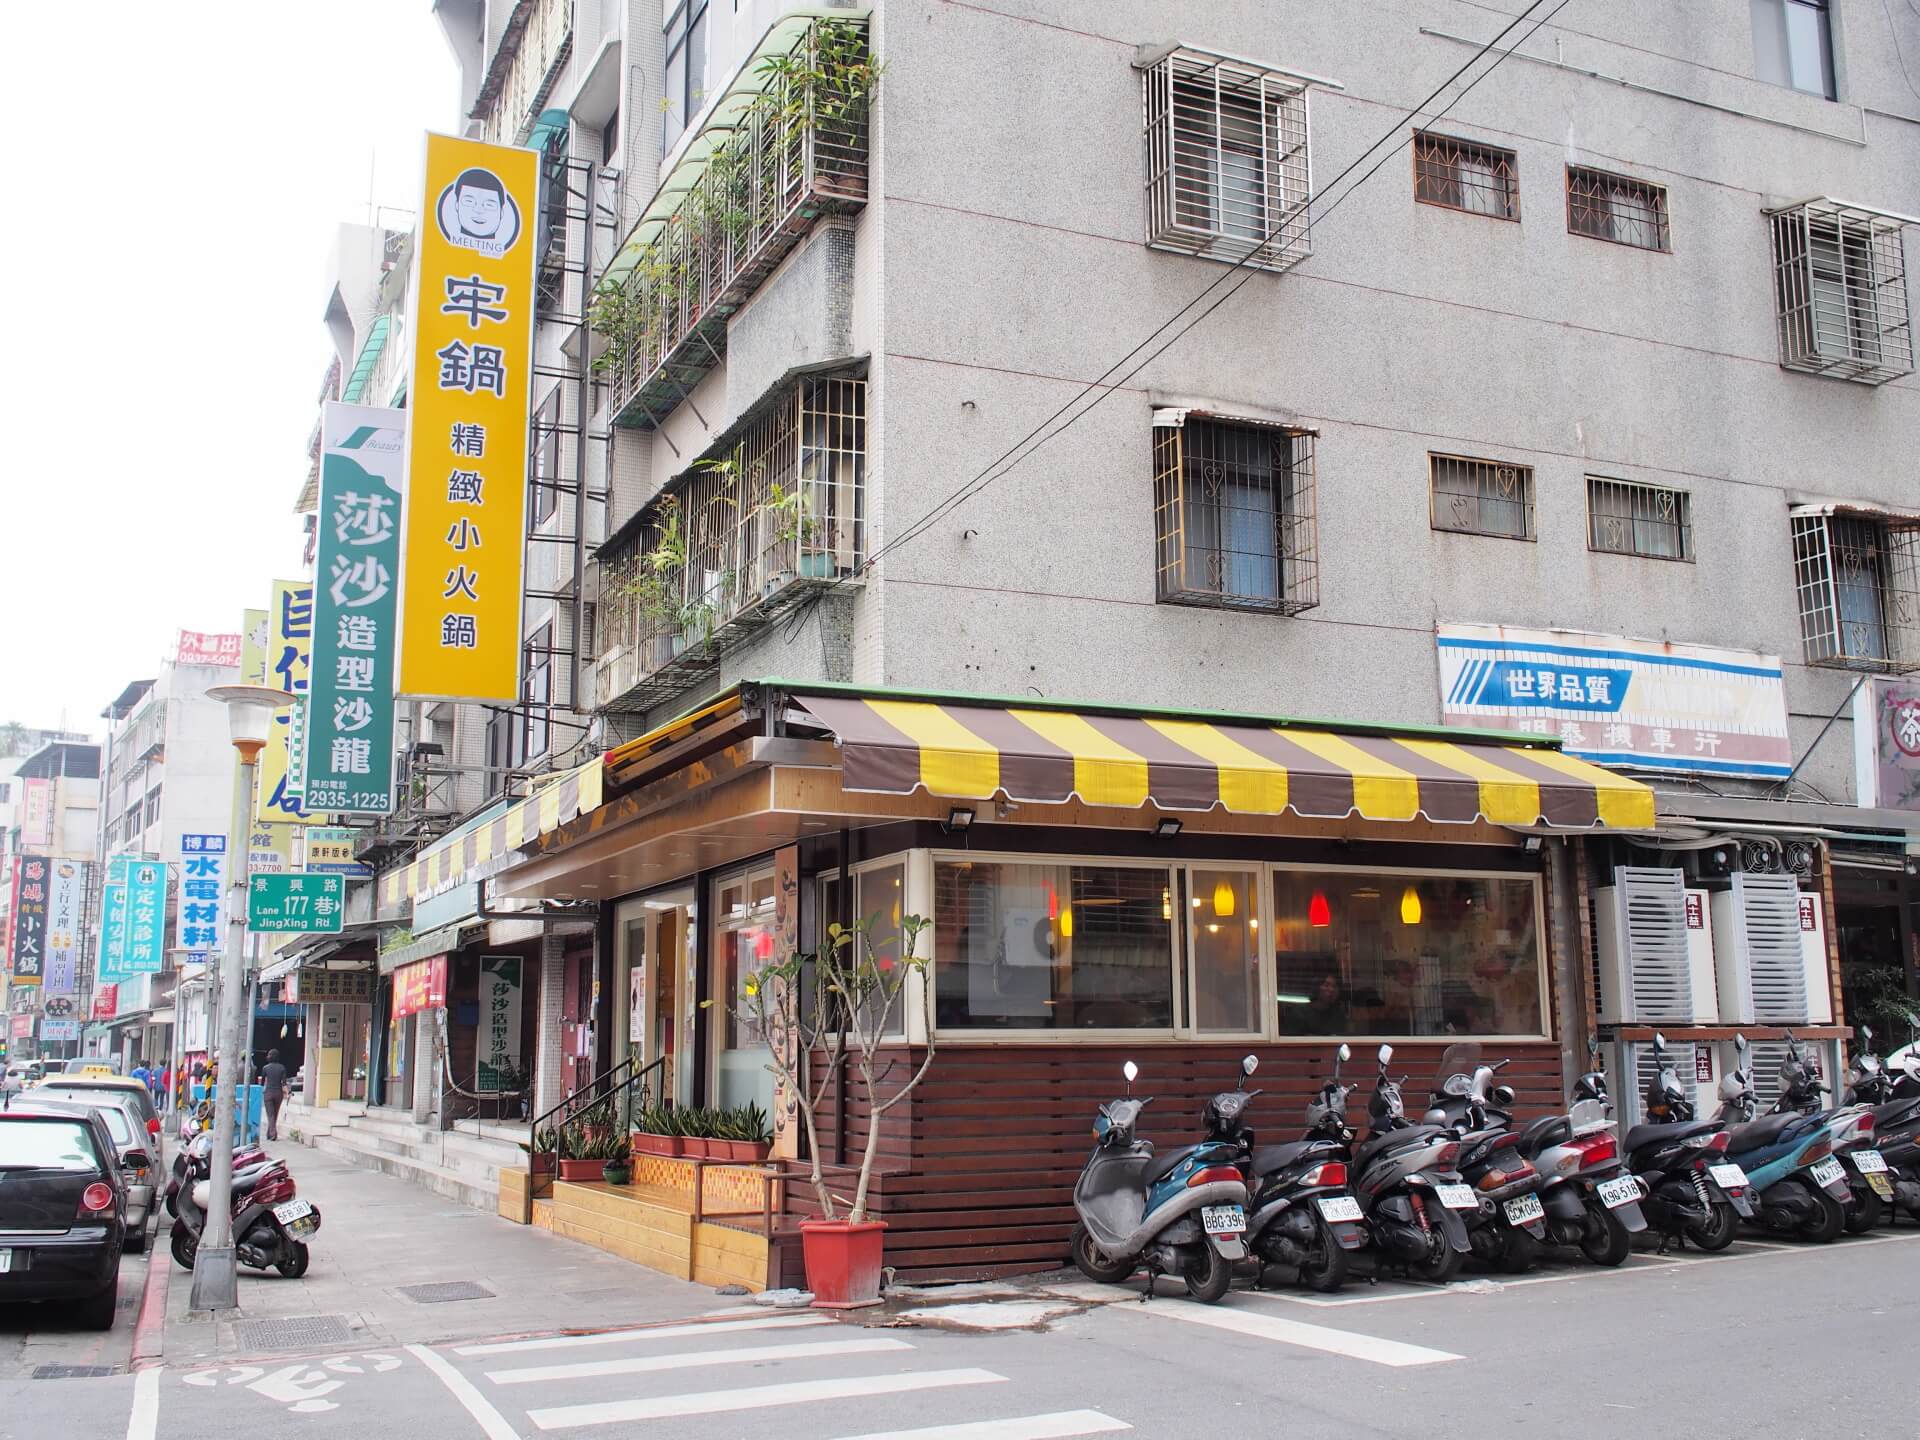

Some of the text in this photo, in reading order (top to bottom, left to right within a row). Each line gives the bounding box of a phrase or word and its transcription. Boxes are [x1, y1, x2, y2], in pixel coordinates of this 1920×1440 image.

[452, 236, 503, 252] MELTING
[439, 276, 507, 397] 牢鍋
[442, 422, 485, 649] 精緻小火鍋
[329, 490, 395, 774] 莎沙造型沙龍
[1506, 669, 1612, 705] 世界品質
[309, 790, 388, 809] 2935-1225
[183, 856, 220, 947] 水電材料
[256, 896, 309, 916] Lane 177
[314, 896, 334, 916] 巷
[259, 918, 333, 930] JingXing Rd.
[1204, 1214, 1245, 1229] BBG-396
